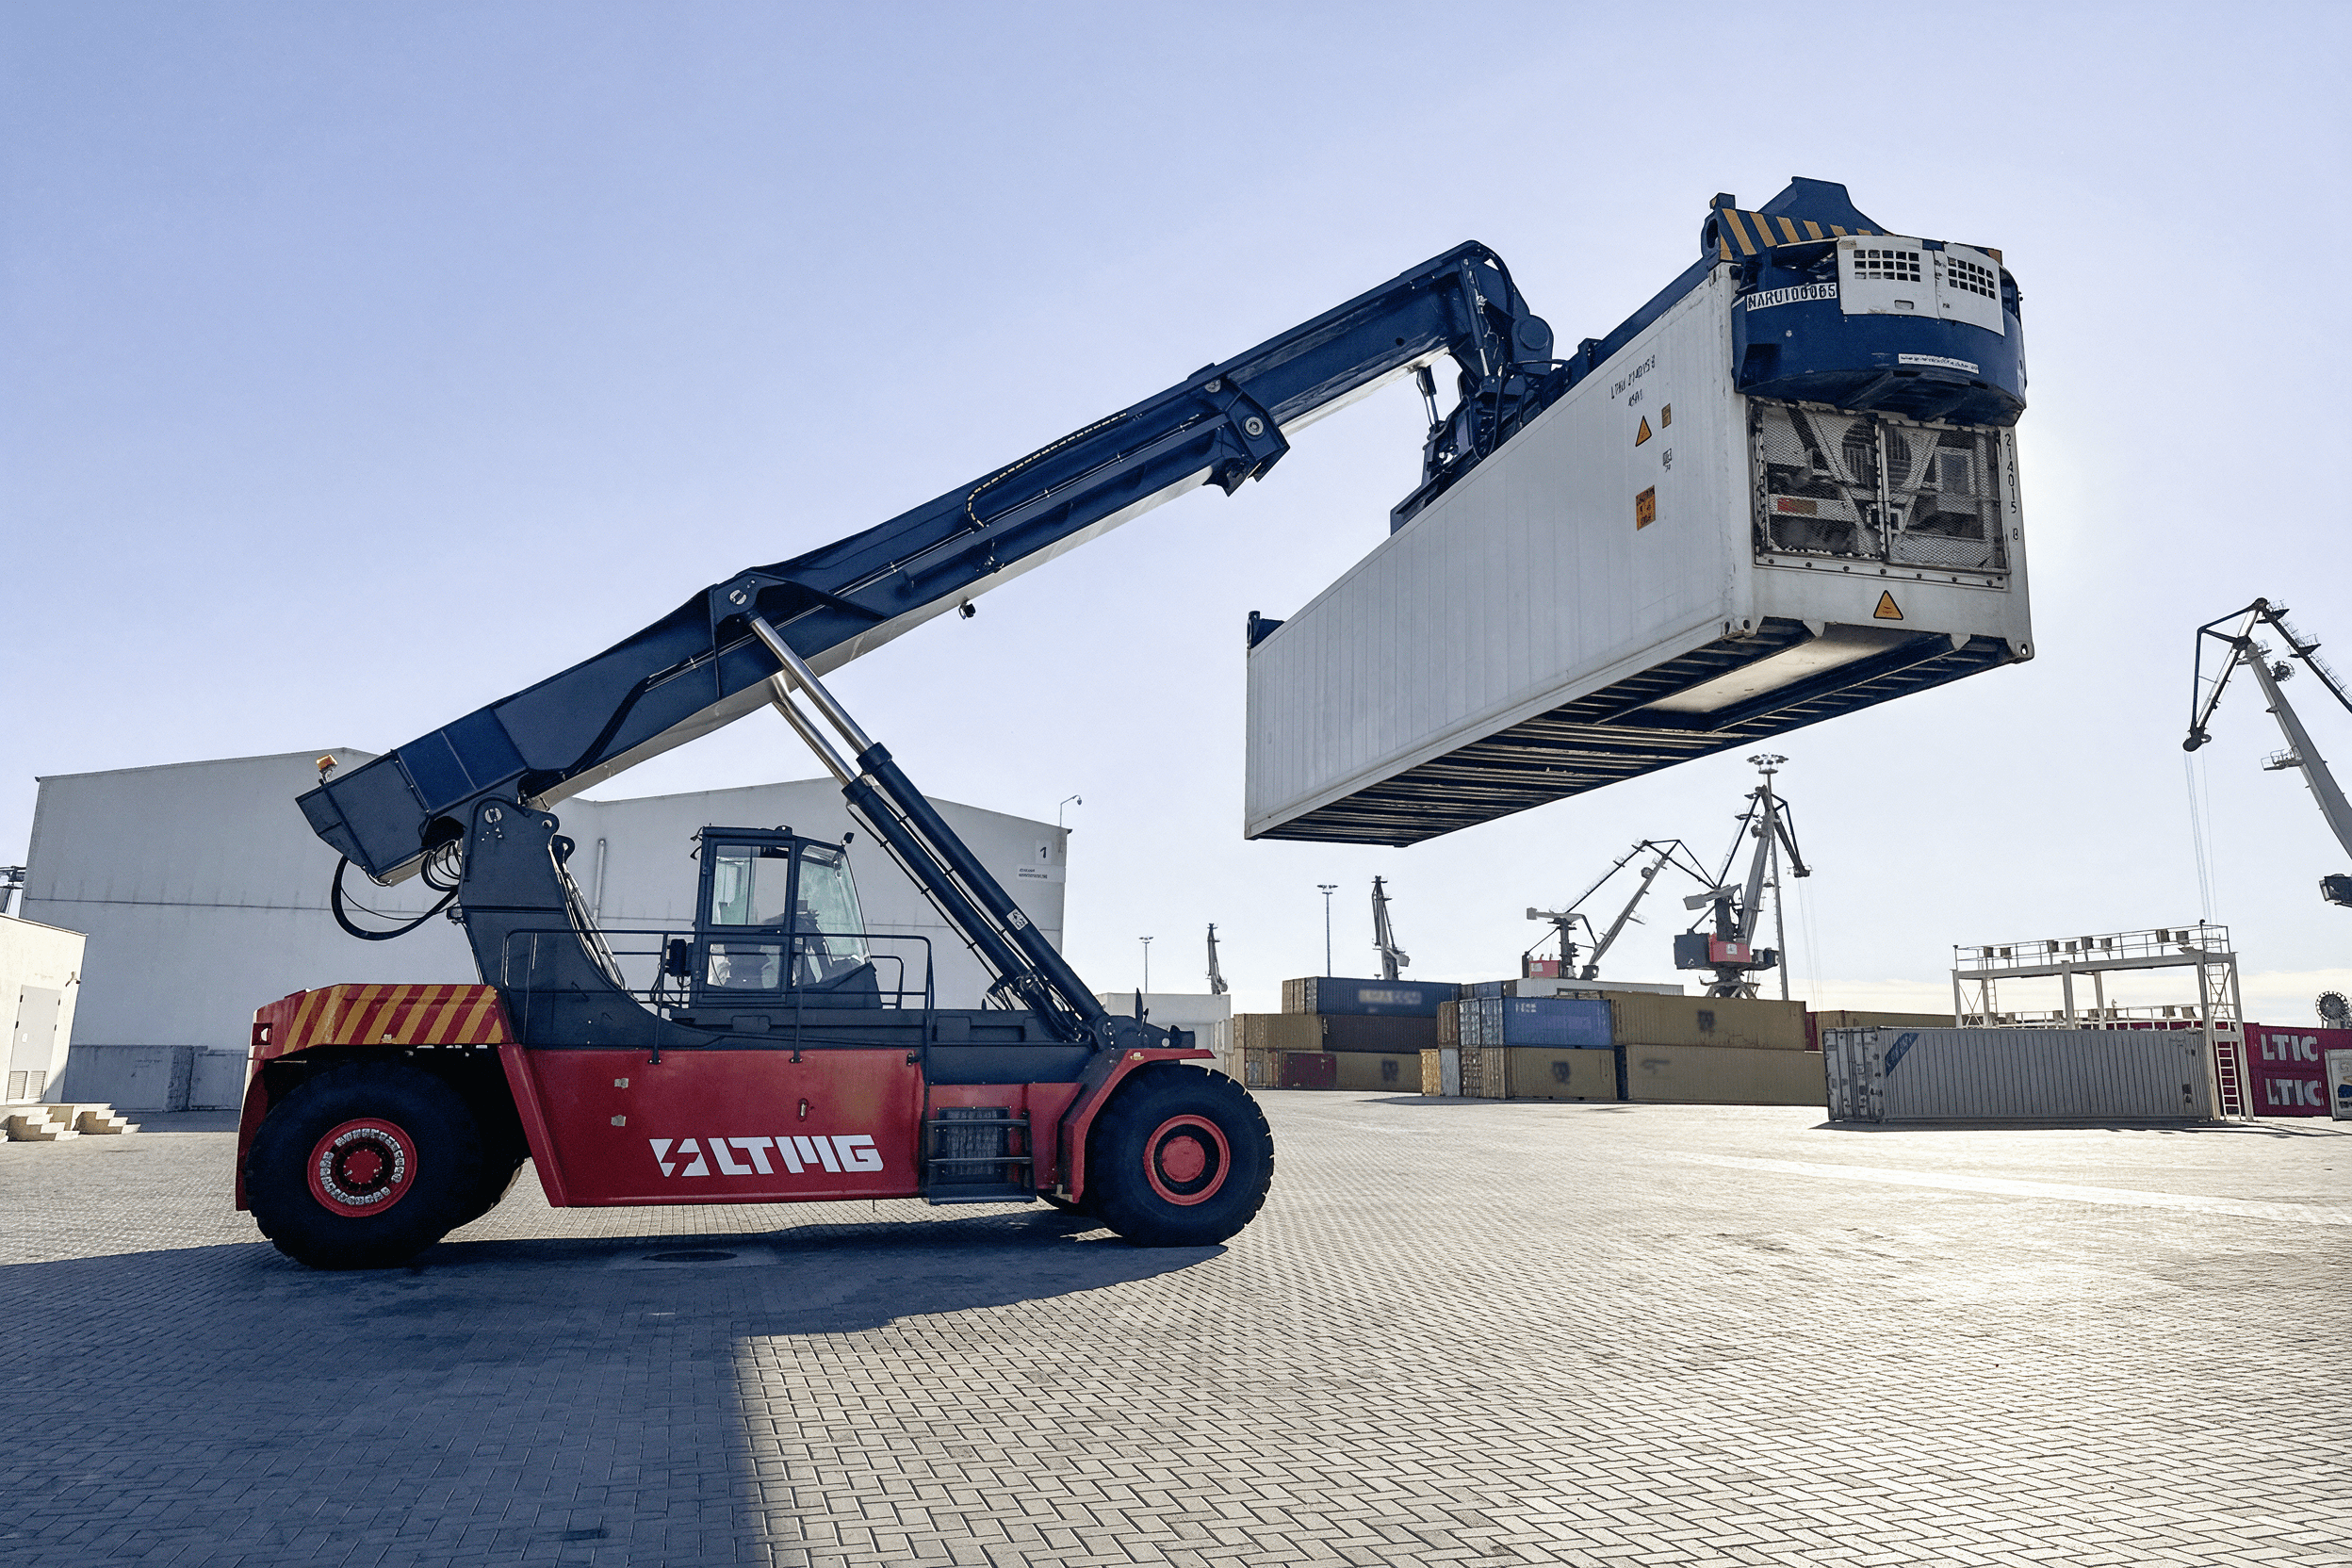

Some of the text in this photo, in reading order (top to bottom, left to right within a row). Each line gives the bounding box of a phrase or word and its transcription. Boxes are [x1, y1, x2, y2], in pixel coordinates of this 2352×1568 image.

[1039, 846, 1047, 858] 1
[2261, 1033, 2319, 1062] LTIC
[2265, 1078, 2324, 1106] LTIC
[708, 1135, 884, 1175] LTMG
